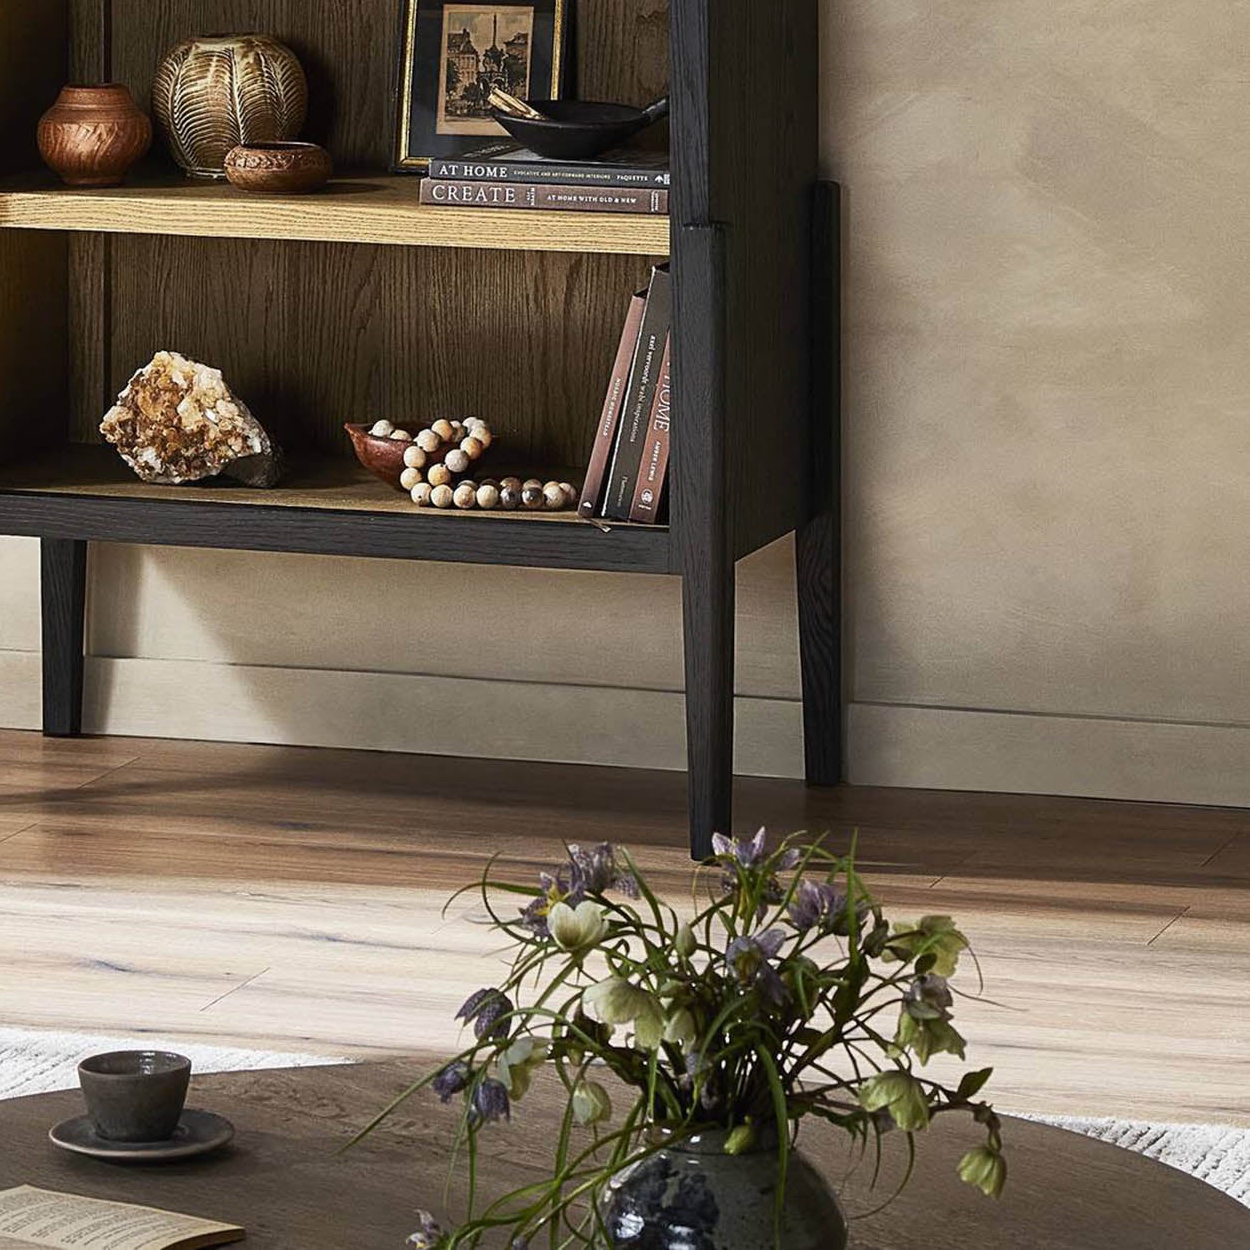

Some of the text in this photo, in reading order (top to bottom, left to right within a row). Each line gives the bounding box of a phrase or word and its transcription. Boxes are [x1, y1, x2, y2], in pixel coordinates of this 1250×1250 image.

[439, 164, 508, 178] AT HOME
[616, 174, 649, 182] PAQUETTE
[432, 185, 516, 203] CREATE
[557, 194, 578, 202] HOME
[579, 195, 598, 203] WITH
[599, 196, 613, 204] OLD
[648, 440, 661, 482] AMBER LEWIS
